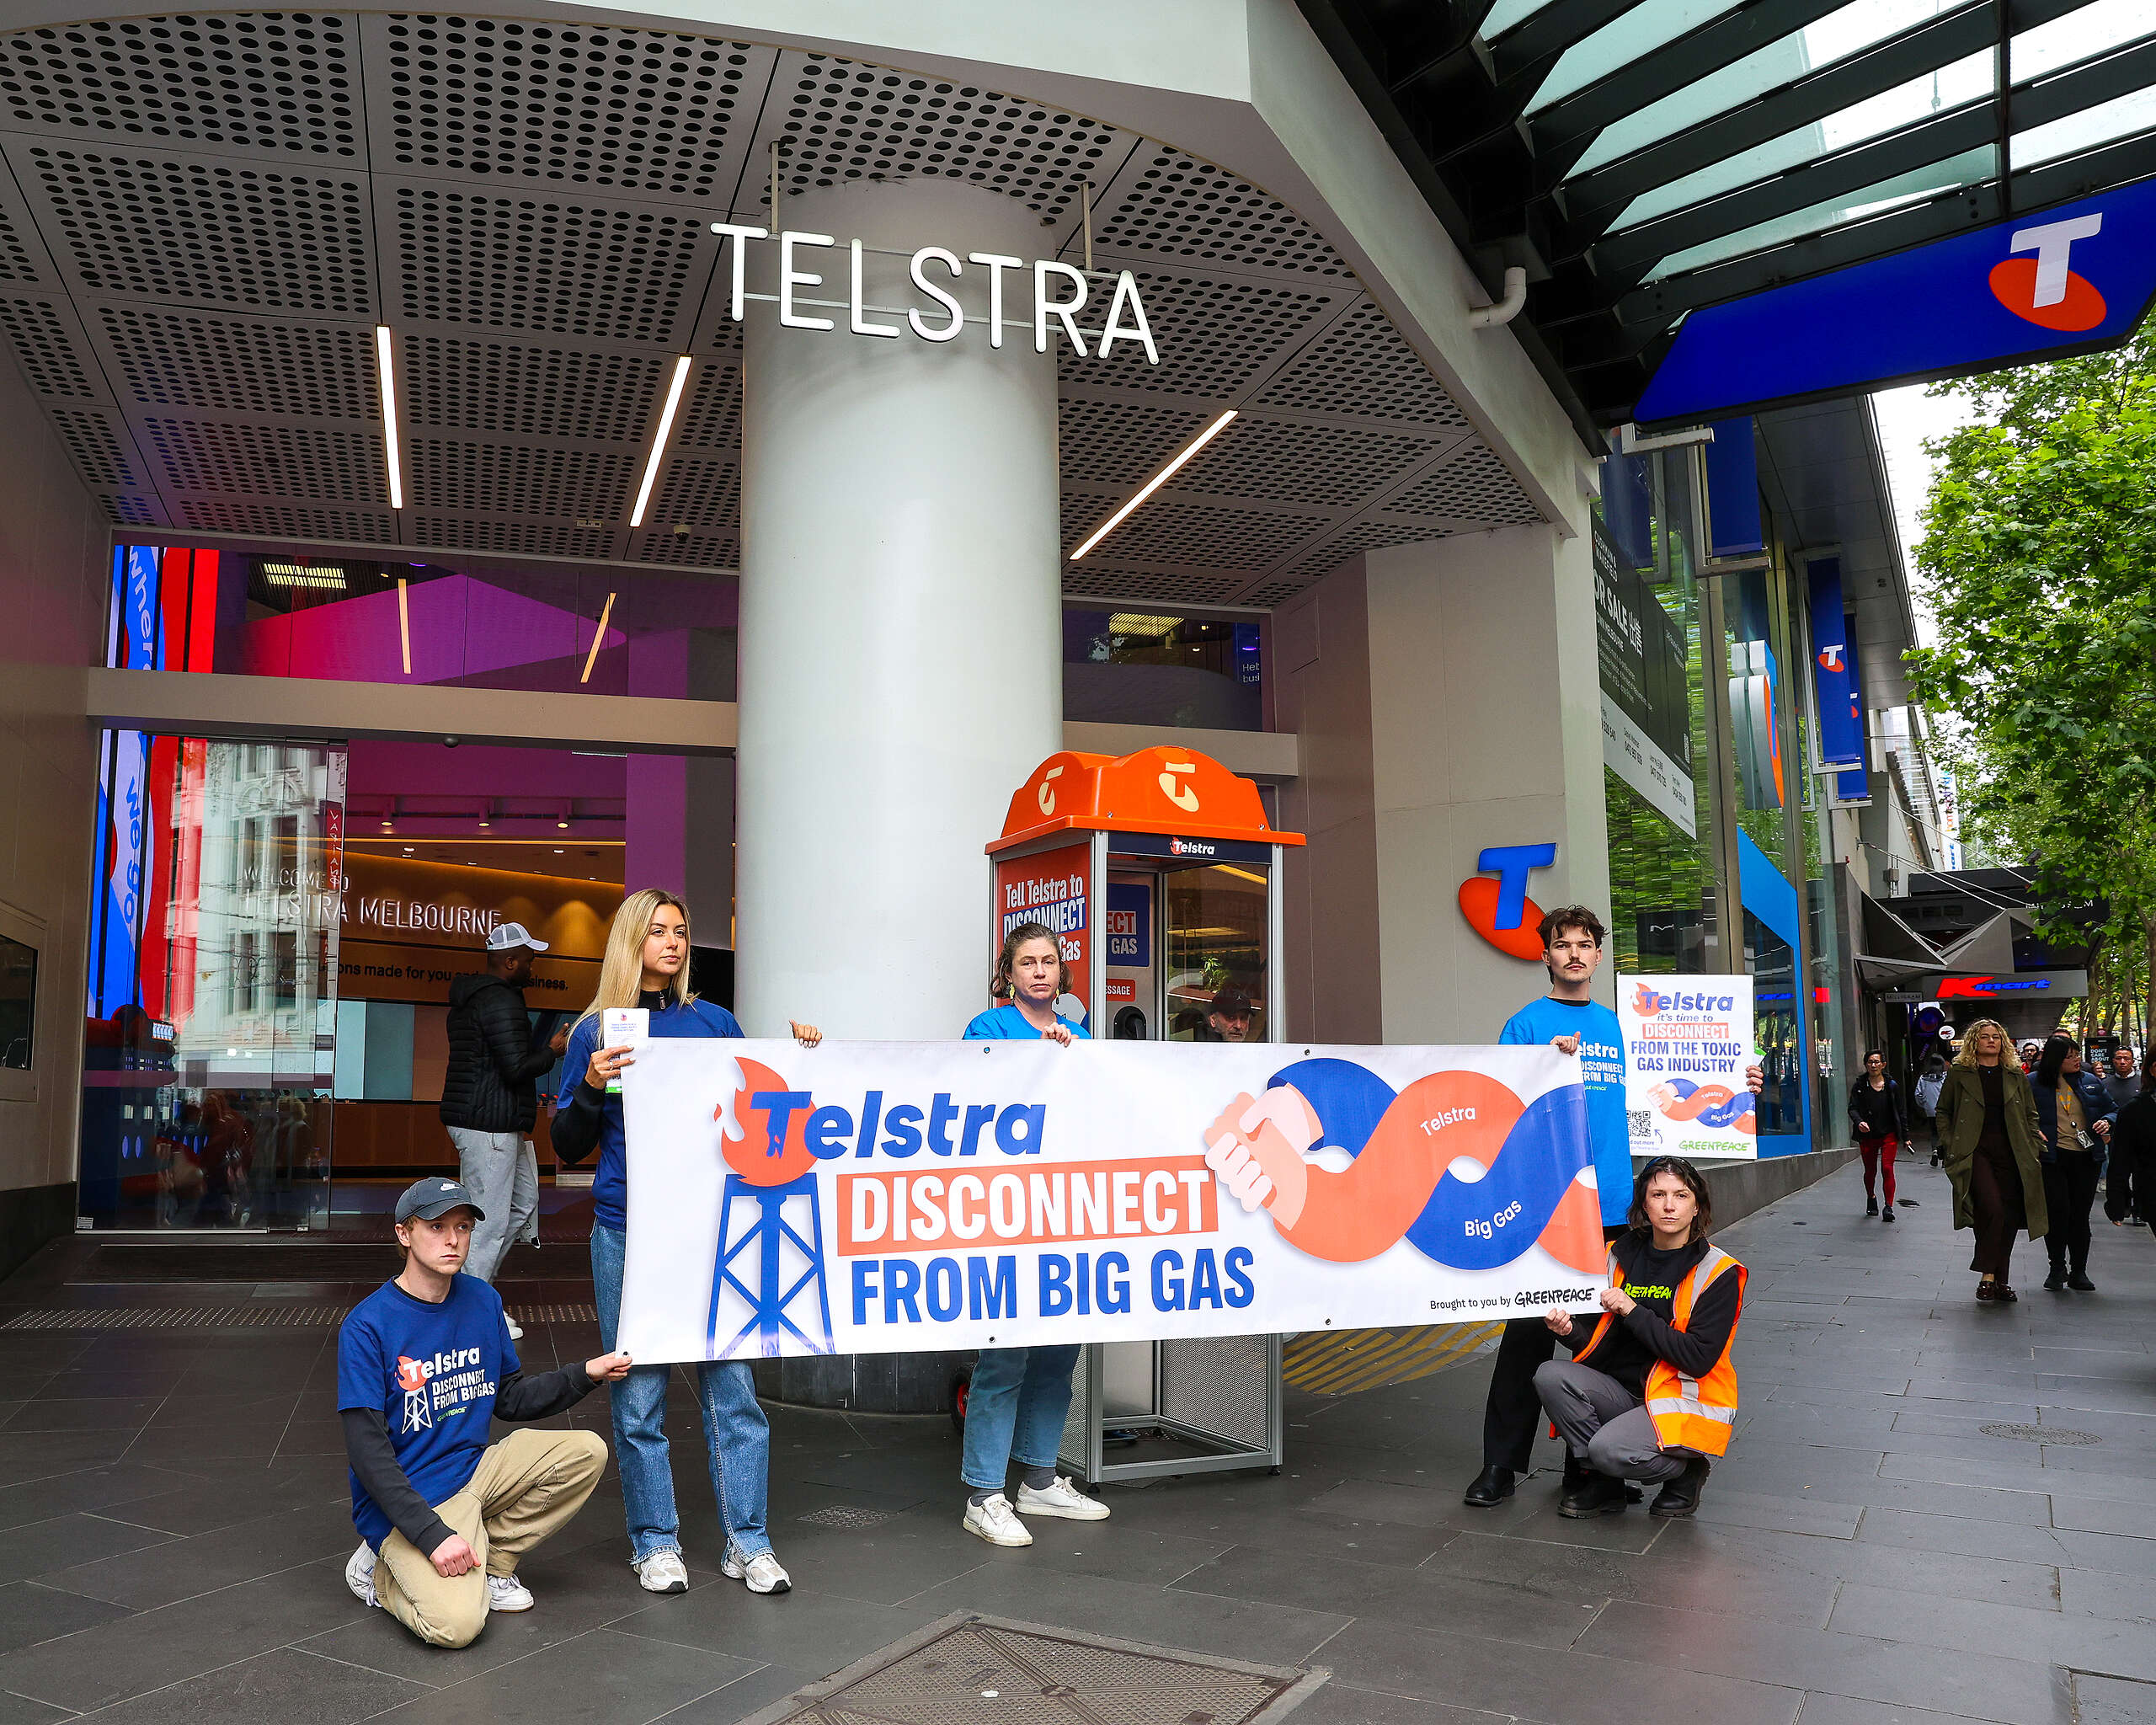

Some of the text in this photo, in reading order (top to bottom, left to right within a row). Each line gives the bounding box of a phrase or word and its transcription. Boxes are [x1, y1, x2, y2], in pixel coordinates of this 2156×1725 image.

[709, 222, 1161, 366] TELSTRA
[1593, 569, 1607, 611] OR
[1607, 586, 1629, 638] SALE
[124, 776, 141, 924] we go
[1173, 841, 1215, 856] Telstra
[243, 866, 327, 890] WLCOME
[1005, 873, 1084, 909] Tell Telstra to
[360, 897, 502, 936] MELBOURNE
[1106, 911, 1135, 934] ECT
[1111, 937, 1138, 955] GAS
[364, 964, 403, 978] made
[406, 965, 424, 980] for
[428, 969, 452, 982] you
[528, 977, 569, 991] siness.
[1935, 976, 2052, 997] Kmart
[1105, 985, 1131, 996] ESSAGE
[1641, 991, 1734, 1012] Telstra
[1676, 1013, 1700, 1022] time
[1703, 1014, 1714, 1023] to
[1645, 1023, 1727, 1039] DISCONNECT
[1577, 1041, 1619, 1059] elstra
[1630, 1041, 1742, 1056] FROM THE TOXIC
[1637, 1057, 1736, 1073] GAS INDUSTRY
[1583, 1071, 1602, 1082] ROM
[1604, 1072, 1618, 1084] BIG
[750, 1090, 1047, 1160] Telstra
[1420, 1107, 1476, 1136] Telstra
[1678, 1140, 1752, 1151] GREENPEACE
[851, 1169, 1211, 1243] DISCONNECT
[1465, 1199, 1523, 1240] Big Gas
[852, 1246, 1255, 1326] FROM BIG GAS
[1430, 1287, 1596, 1311] Brought to you by GREENPEACE
[403, 1348, 480, 1382] Telstra
[432, 1369, 485, 1397] DISCONNECT
[433, 1389, 459, 1411] FROM
[477, 1381, 496, 1397] GAS
